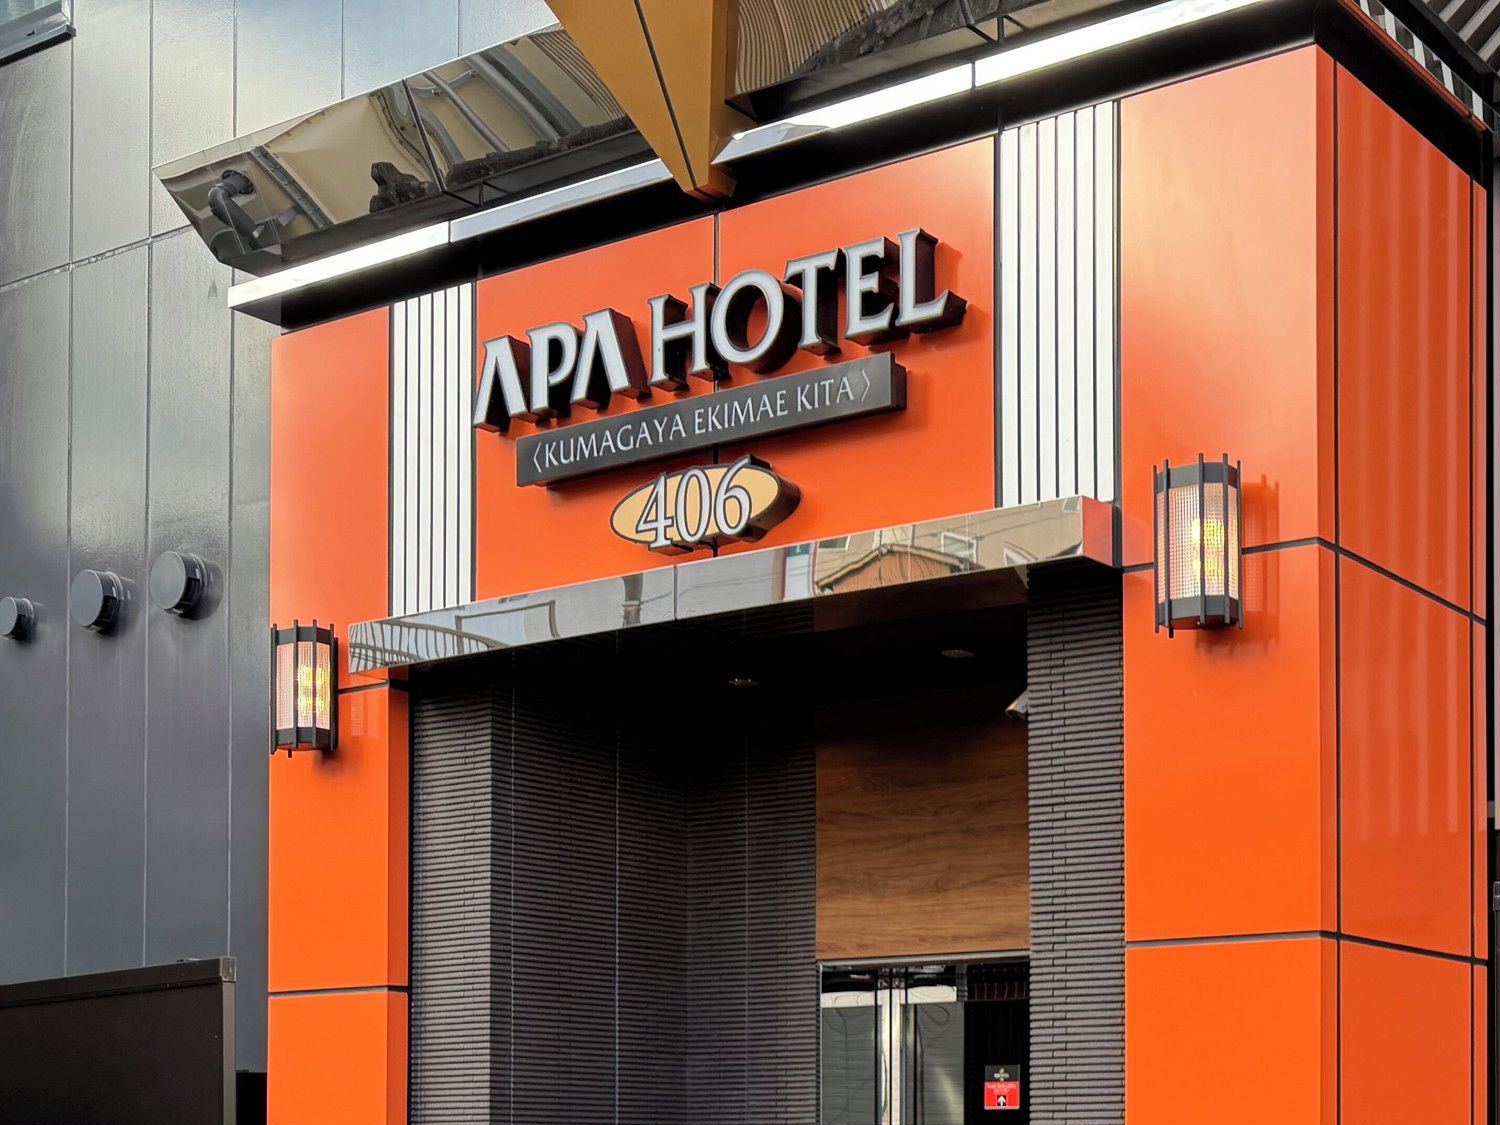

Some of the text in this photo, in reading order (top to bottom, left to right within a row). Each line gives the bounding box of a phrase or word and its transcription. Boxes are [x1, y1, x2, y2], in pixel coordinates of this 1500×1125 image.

[474, 229, 956, 430] APA HOTEL
[694, 389, 789, 435] EKIMAE
[635, 457, 752, 550] 406
